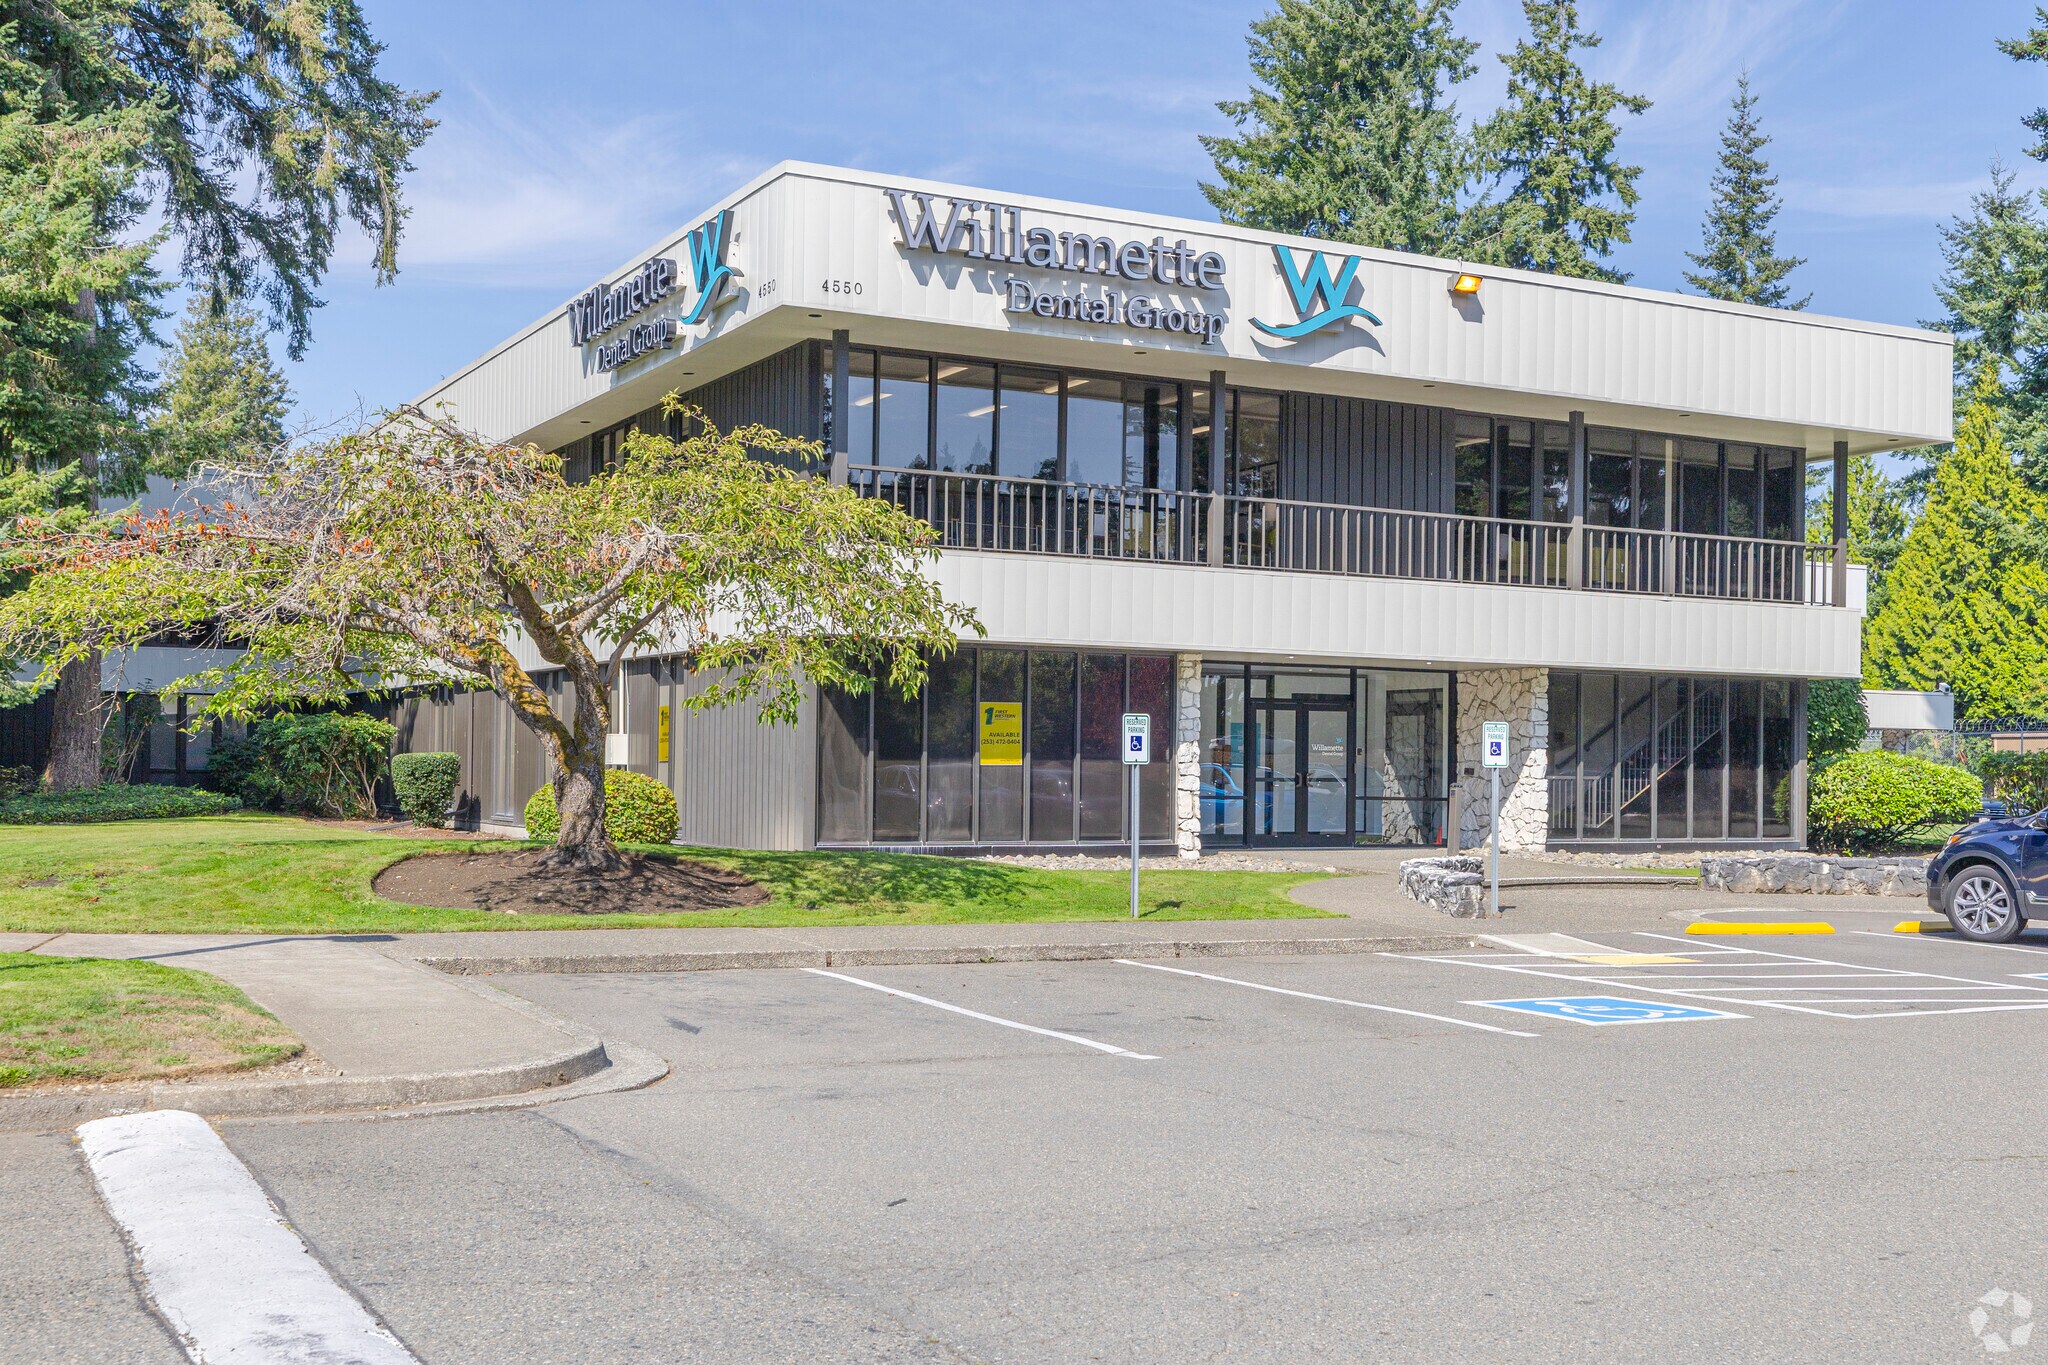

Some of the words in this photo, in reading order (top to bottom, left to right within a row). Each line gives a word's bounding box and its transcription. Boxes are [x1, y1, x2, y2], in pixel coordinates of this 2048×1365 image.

[884, 187, 1226, 291] Willamette
[566, 258, 677, 347] Willamette
[758, 279, 776, 298] 4550
[821, 279, 863, 295] 4550
[1005, 279, 1120, 324] Dental
[1125, 294, 1225, 345] Group
[597, 328, 634, 373] Dental
[632, 317, 677, 354] Group
[985, 707, 994, 725] 1
[1126, 718, 1146, 726] RESERVED
